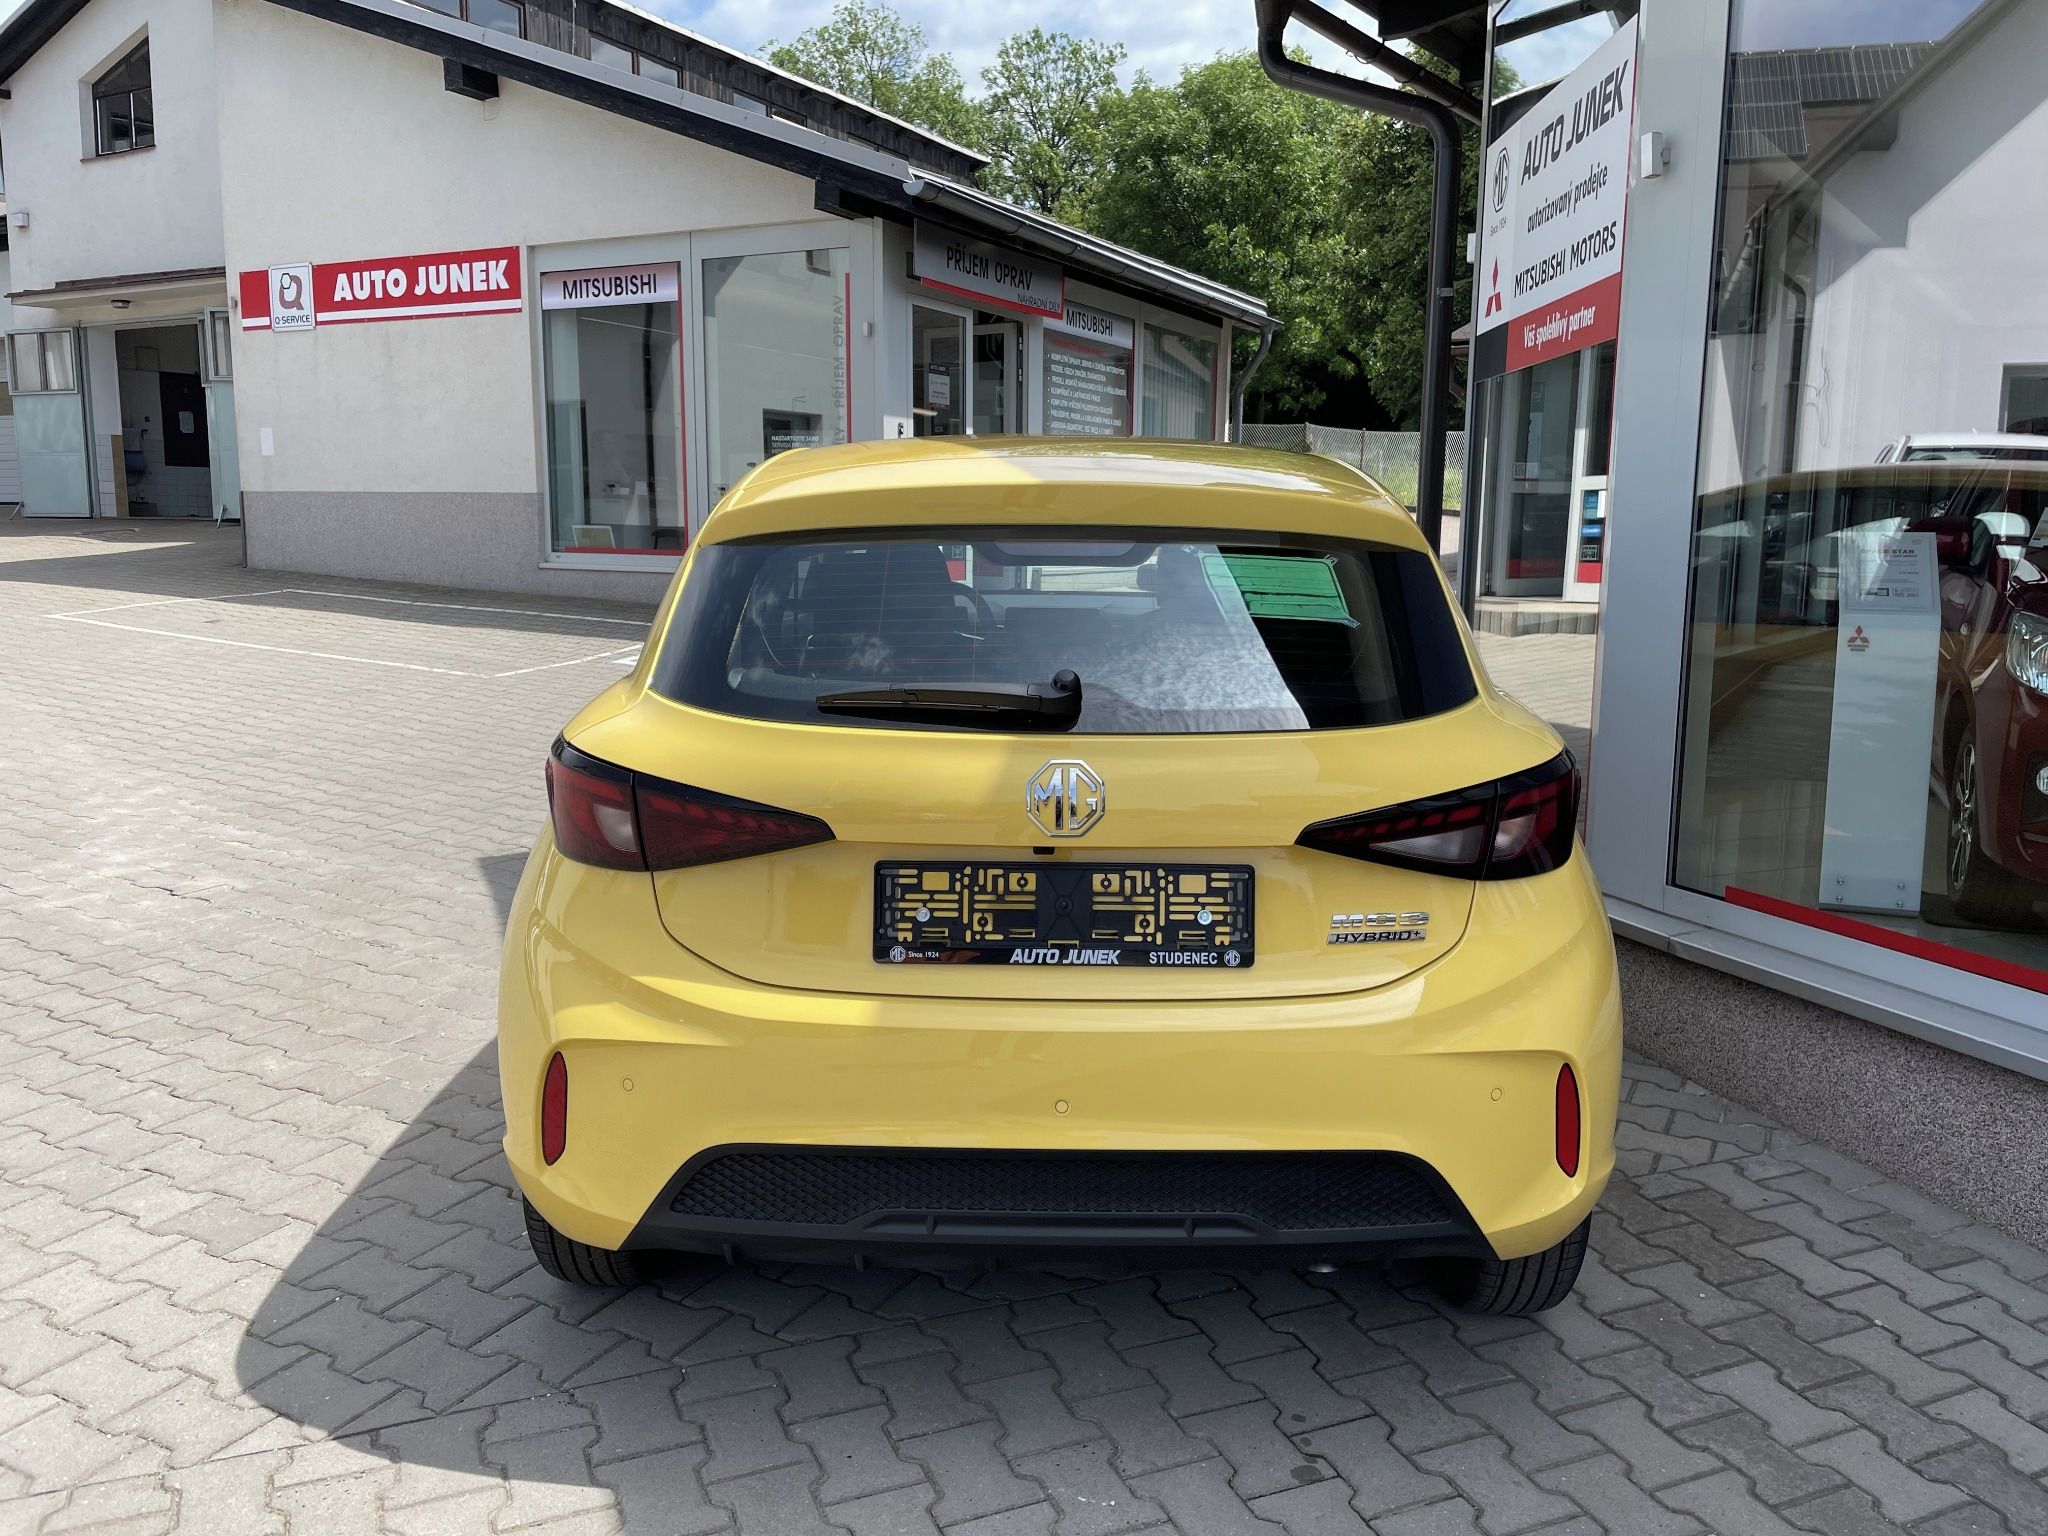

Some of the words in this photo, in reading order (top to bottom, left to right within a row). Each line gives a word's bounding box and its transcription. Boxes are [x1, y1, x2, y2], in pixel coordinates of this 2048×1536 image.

[1521, 114, 1564, 186] AUTO
[1565, 59, 1629, 152] JUNEK
[1527, 181, 1573, 233] autorizovaný
[1574, 162, 1607, 213] prodejce
[334, 268, 407, 301] AUTO
[414, 259, 510, 296] JUNEK
[946, 243, 989, 279] PŘÍJEM
[994, 262, 1032, 291] OPRAV
[1514, 249, 1566, 298] MITSUBISHI
[1570, 221, 1616, 271] MOTORS
[562, 273, 657, 300] MITSUBISHI
[832, 295, 844, 347] OPRAV
[1066, 309, 1113, 337] MITSUBISHI
[1524, 323, 1535, 349] Váš
[1536, 309, 1568, 351] spolehlivý
[1568, 305, 1596, 341] partner
[1031, 765, 1099, 832] MG
[1330, 912, 1430, 928] MG3
[890, 946, 905, 961] MG
[1009, 948, 1060, 964] AUTO
[1062, 949, 1122, 965] JUNEK
[1149, 951, 1218, 965] STUDENEC
[1224, 951, 1240, 965] MG
